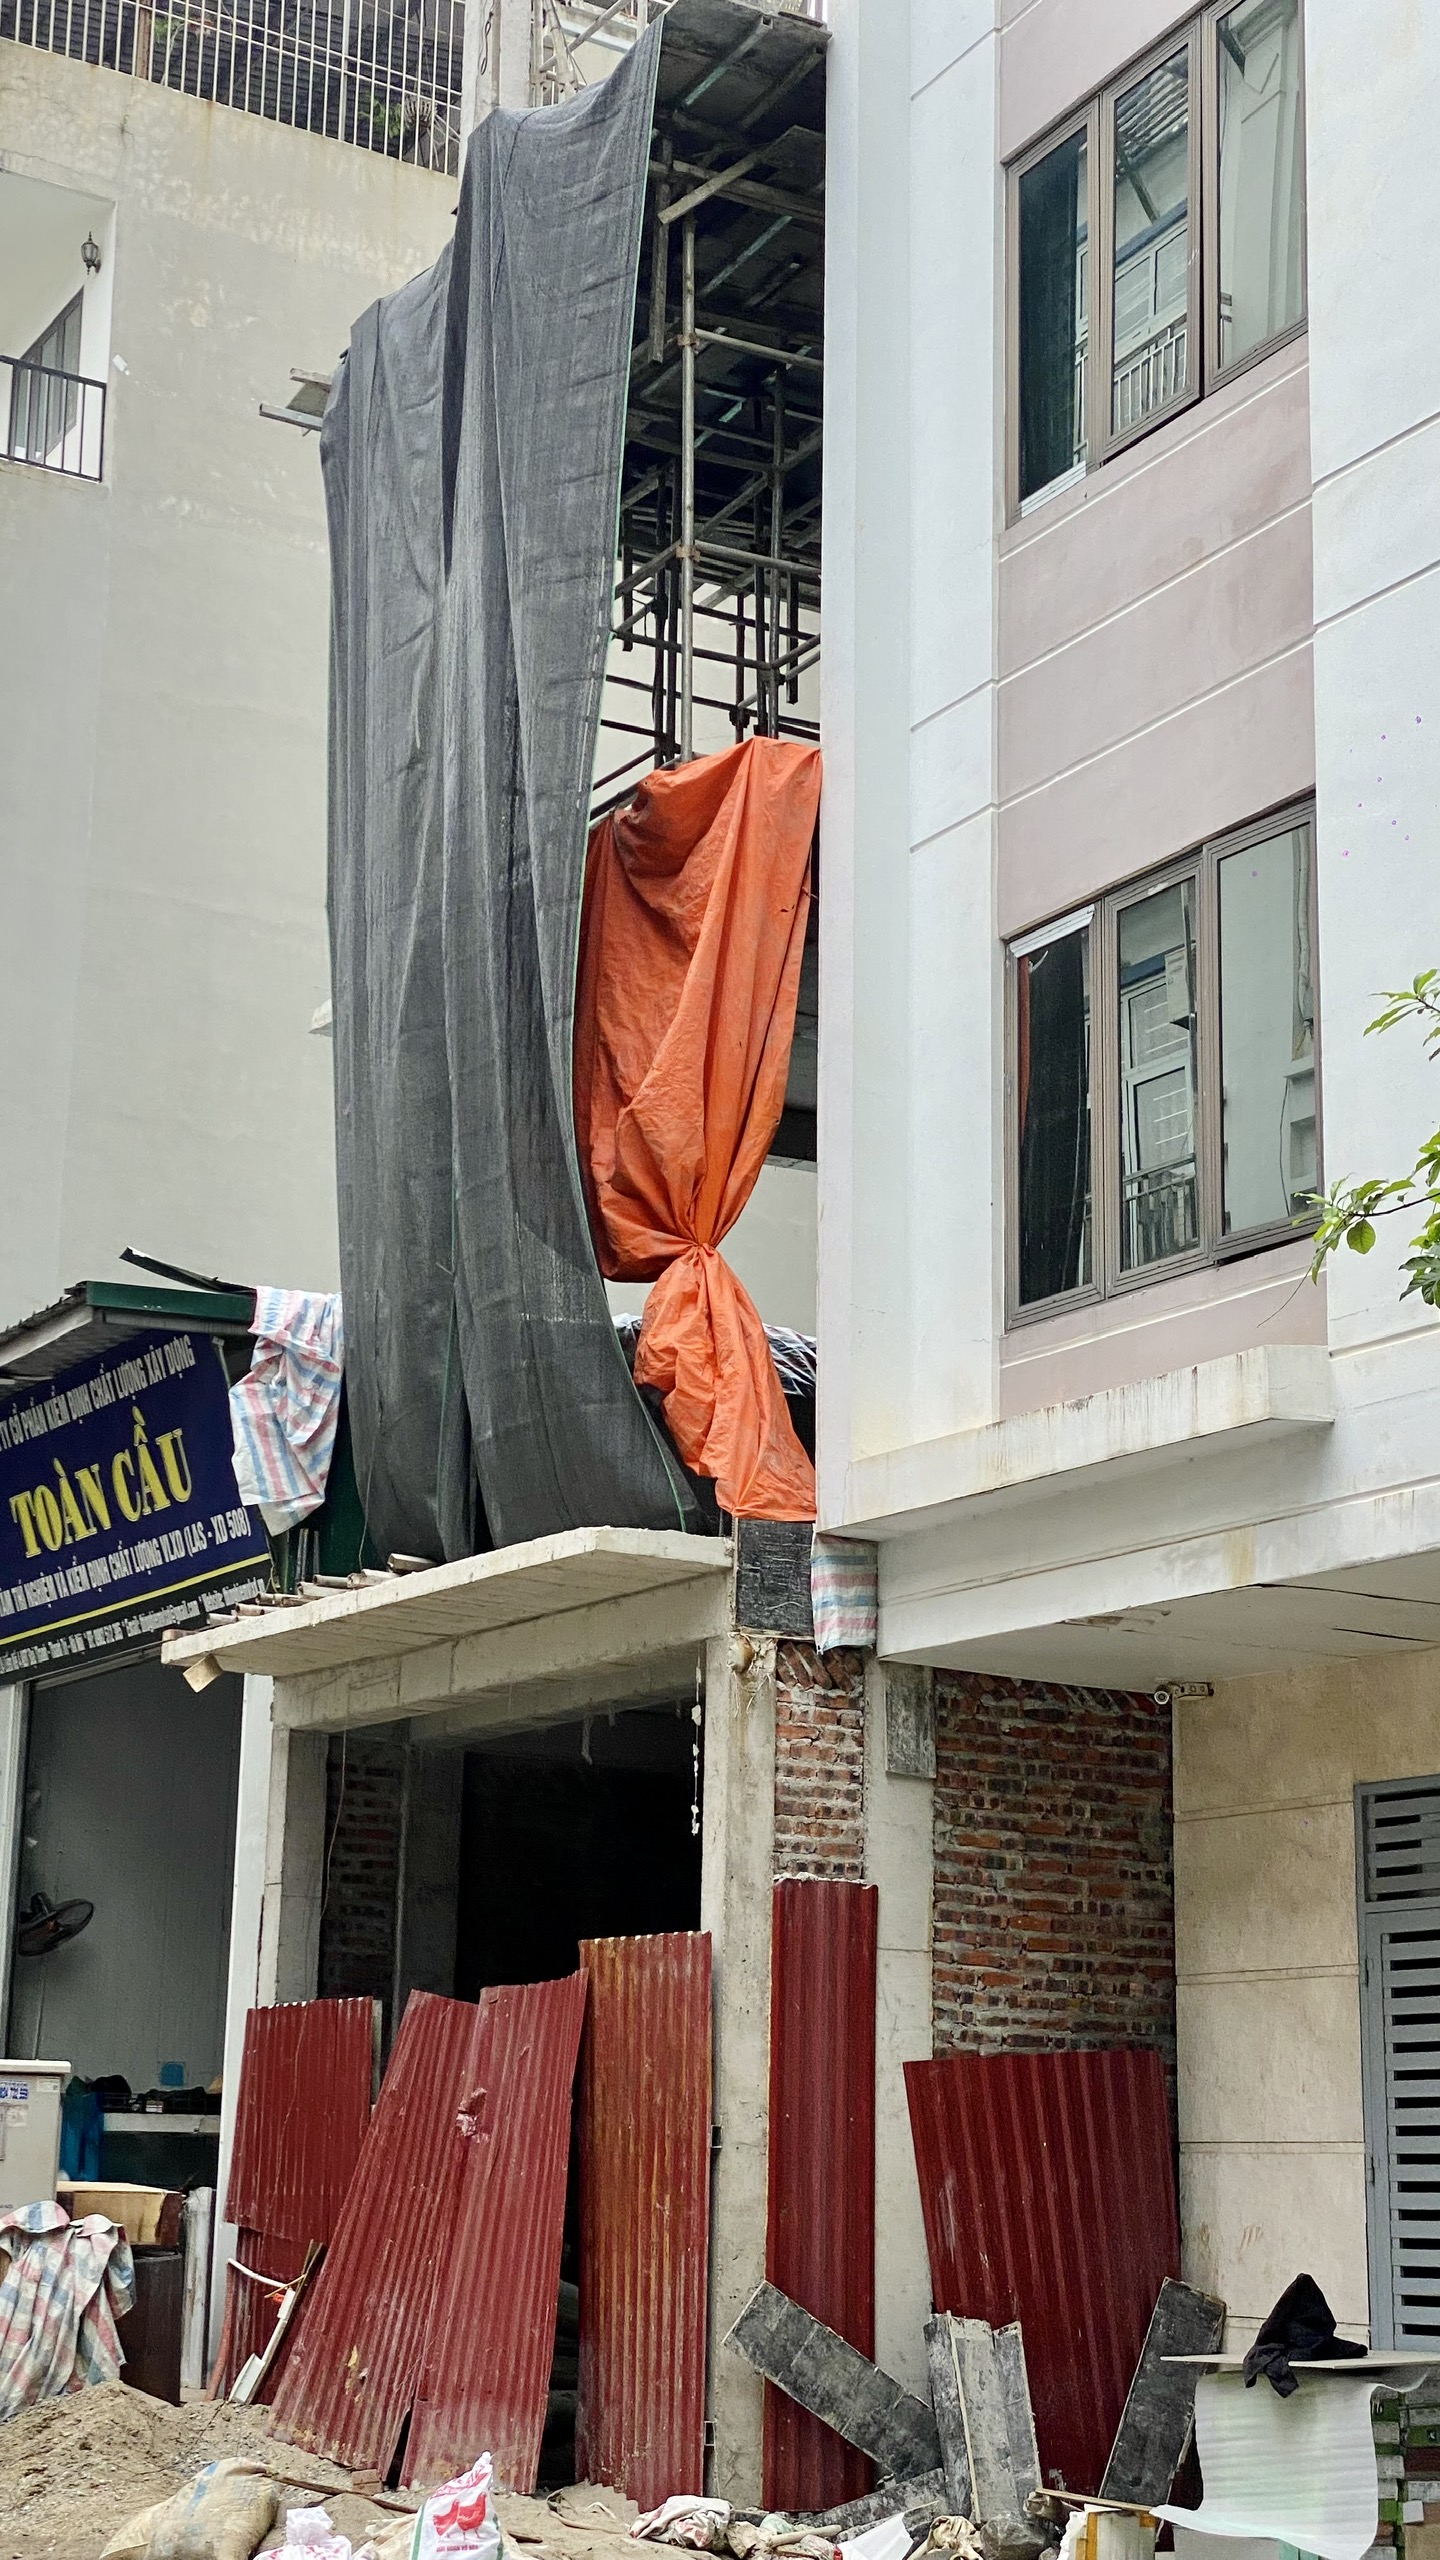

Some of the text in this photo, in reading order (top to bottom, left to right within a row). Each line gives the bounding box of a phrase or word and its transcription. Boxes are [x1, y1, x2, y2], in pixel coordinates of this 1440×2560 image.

[89, 1362, 116, 1410] CHẤT
[116, 1359, 148, 1400] LƯỢNG
[144, 1345, 167, 1385] XÂY
[163, 1334, 196, 1379] DỰNG
[9, 1405, 193, 1558] TOÀN CẦU
[108, 1540, 133, 1580] CHẤT
[129, 1539, 163, 1575] LƯỢNG
[159, 1529, 186, 1563] VLXD
[210, 1513, 228, 1545] XD
